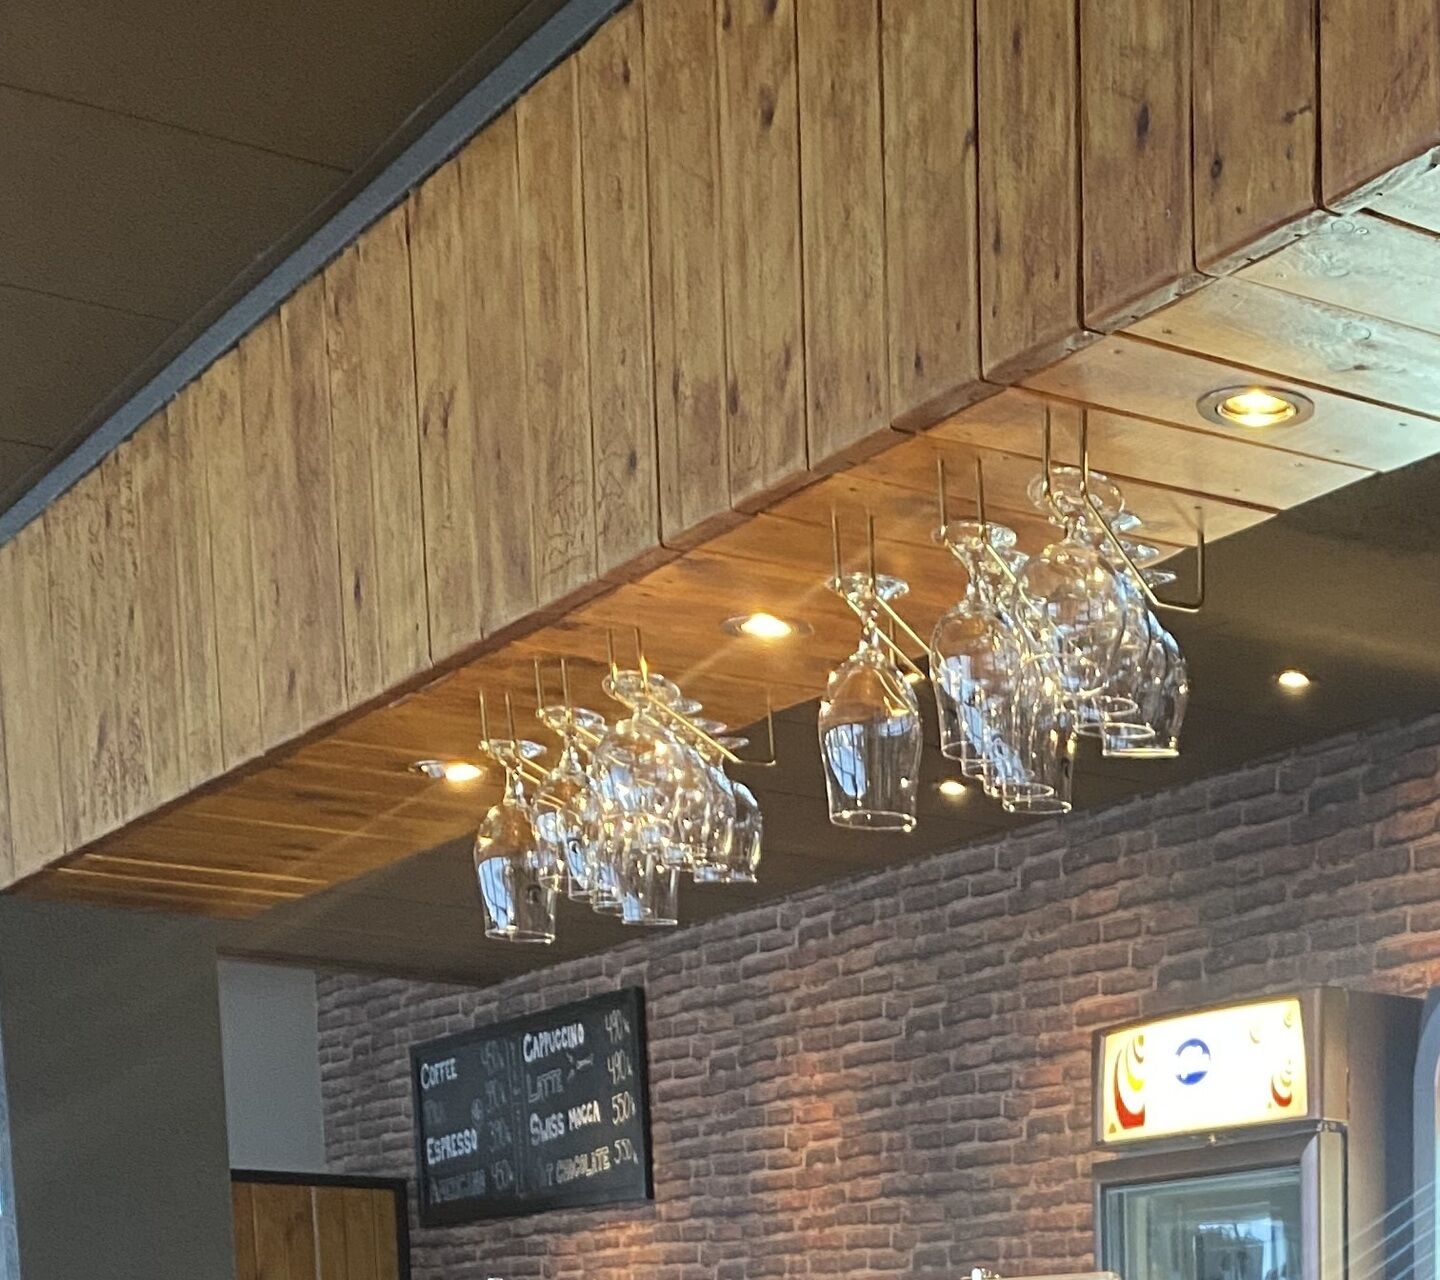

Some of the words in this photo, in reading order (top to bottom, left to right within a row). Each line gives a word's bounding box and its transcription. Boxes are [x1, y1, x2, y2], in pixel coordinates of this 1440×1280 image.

[420, 1058, 458, 1090] COFFEE
[527, 1068, 563, 1103] LATTE
[530, 1112, 565, 1146] SWISS
[426, 1128, 477, 1165] ESPRESSO
